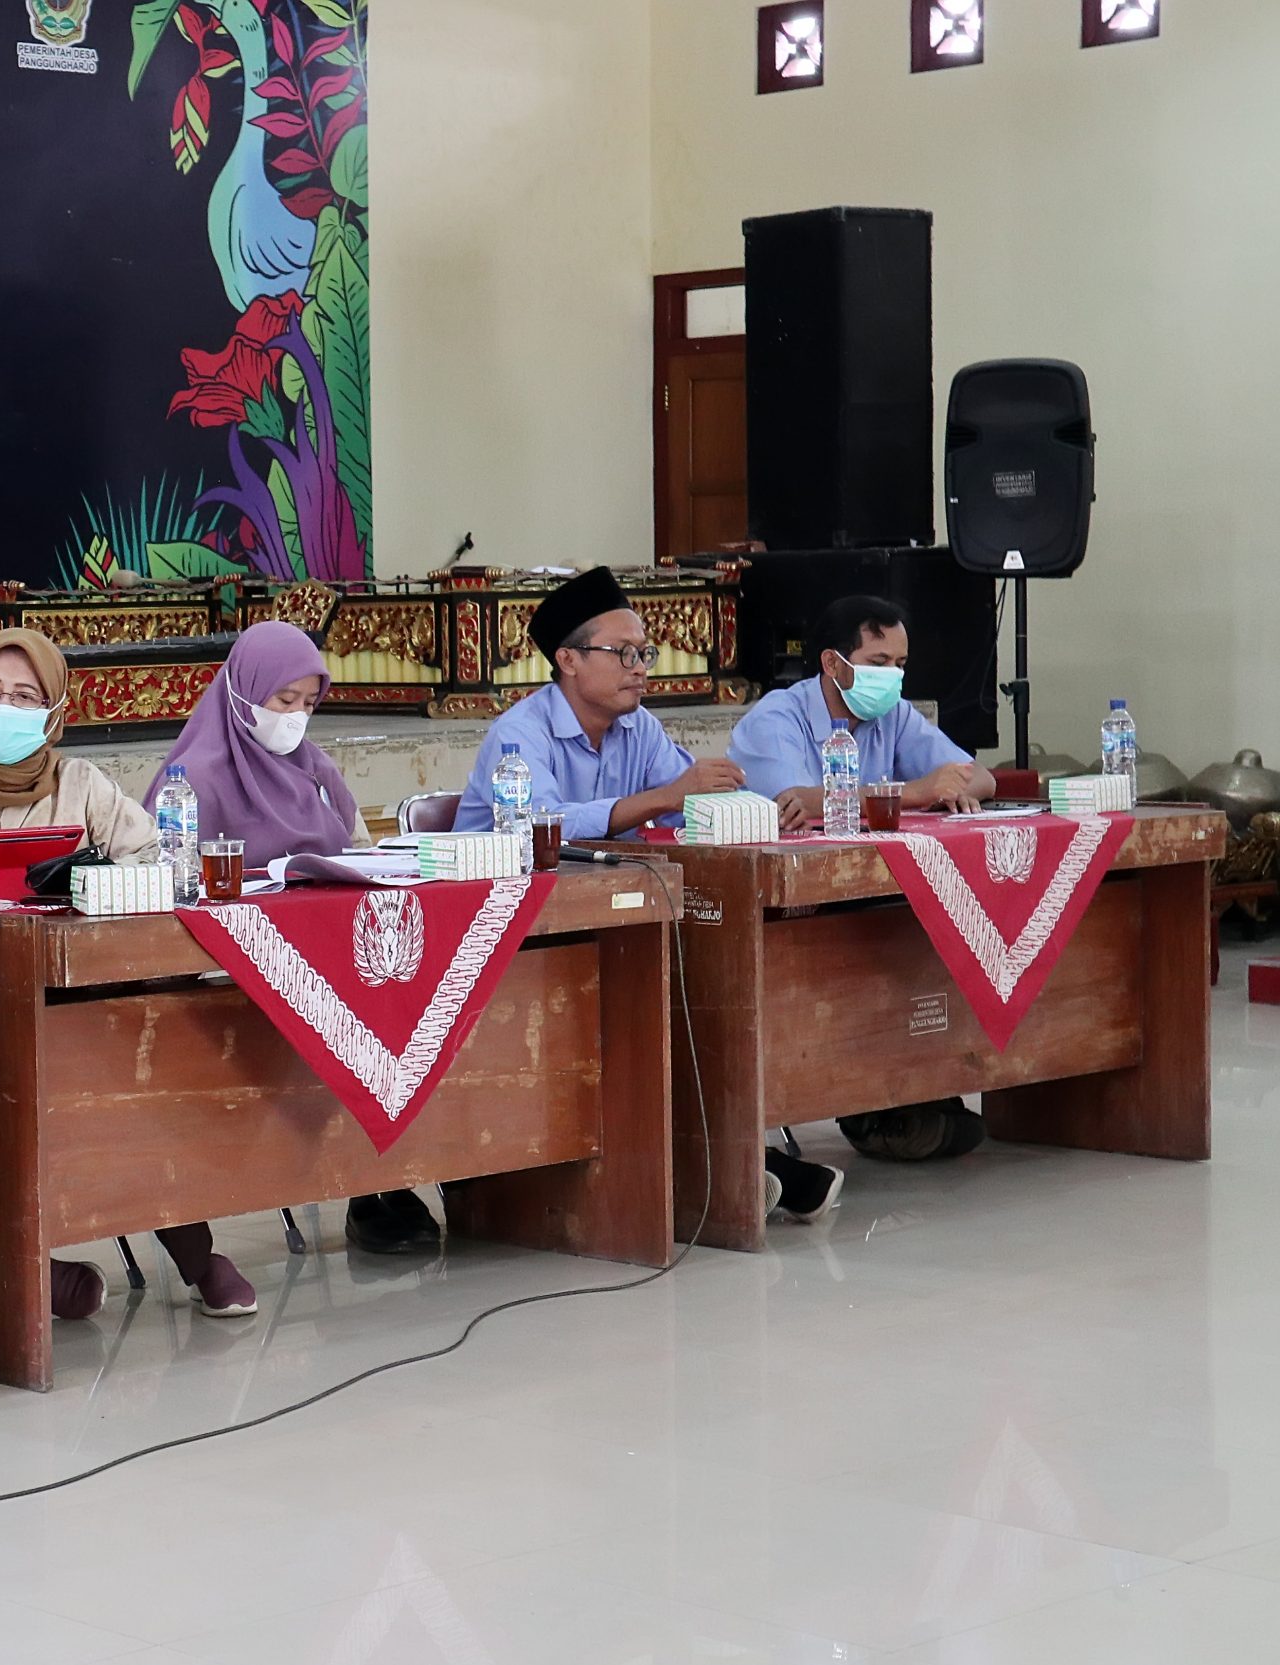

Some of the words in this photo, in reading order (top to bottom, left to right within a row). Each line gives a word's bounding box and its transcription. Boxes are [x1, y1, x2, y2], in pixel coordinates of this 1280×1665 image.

[18, 44, 71, 58] PEMERINTAH
[73, 49, 96, 60] DESA
[20, 56, 96, 72] PANGGUNGHARJO
